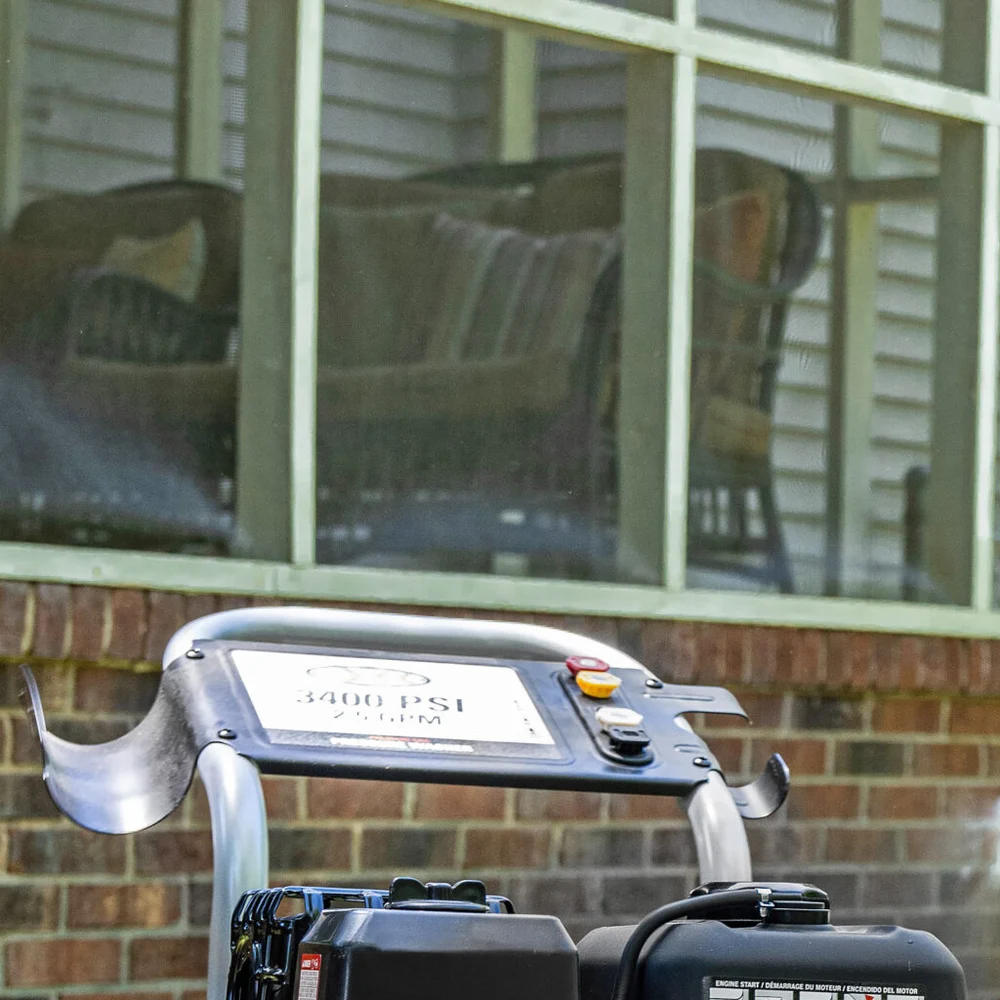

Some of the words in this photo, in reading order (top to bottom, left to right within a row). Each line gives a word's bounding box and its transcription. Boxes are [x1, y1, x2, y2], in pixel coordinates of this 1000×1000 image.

[297, 690, 383, 707] 3400
[401, 695, 463, 712] PSI
[715, 980, 739, 988] ENGINE
[740, 981, 760, 989] START
[765, 982, 804, 990] DÉMARRAGE
[847, 985, 882, 993] ENCENDIDO
[883, 986, 895, 994] DEL
